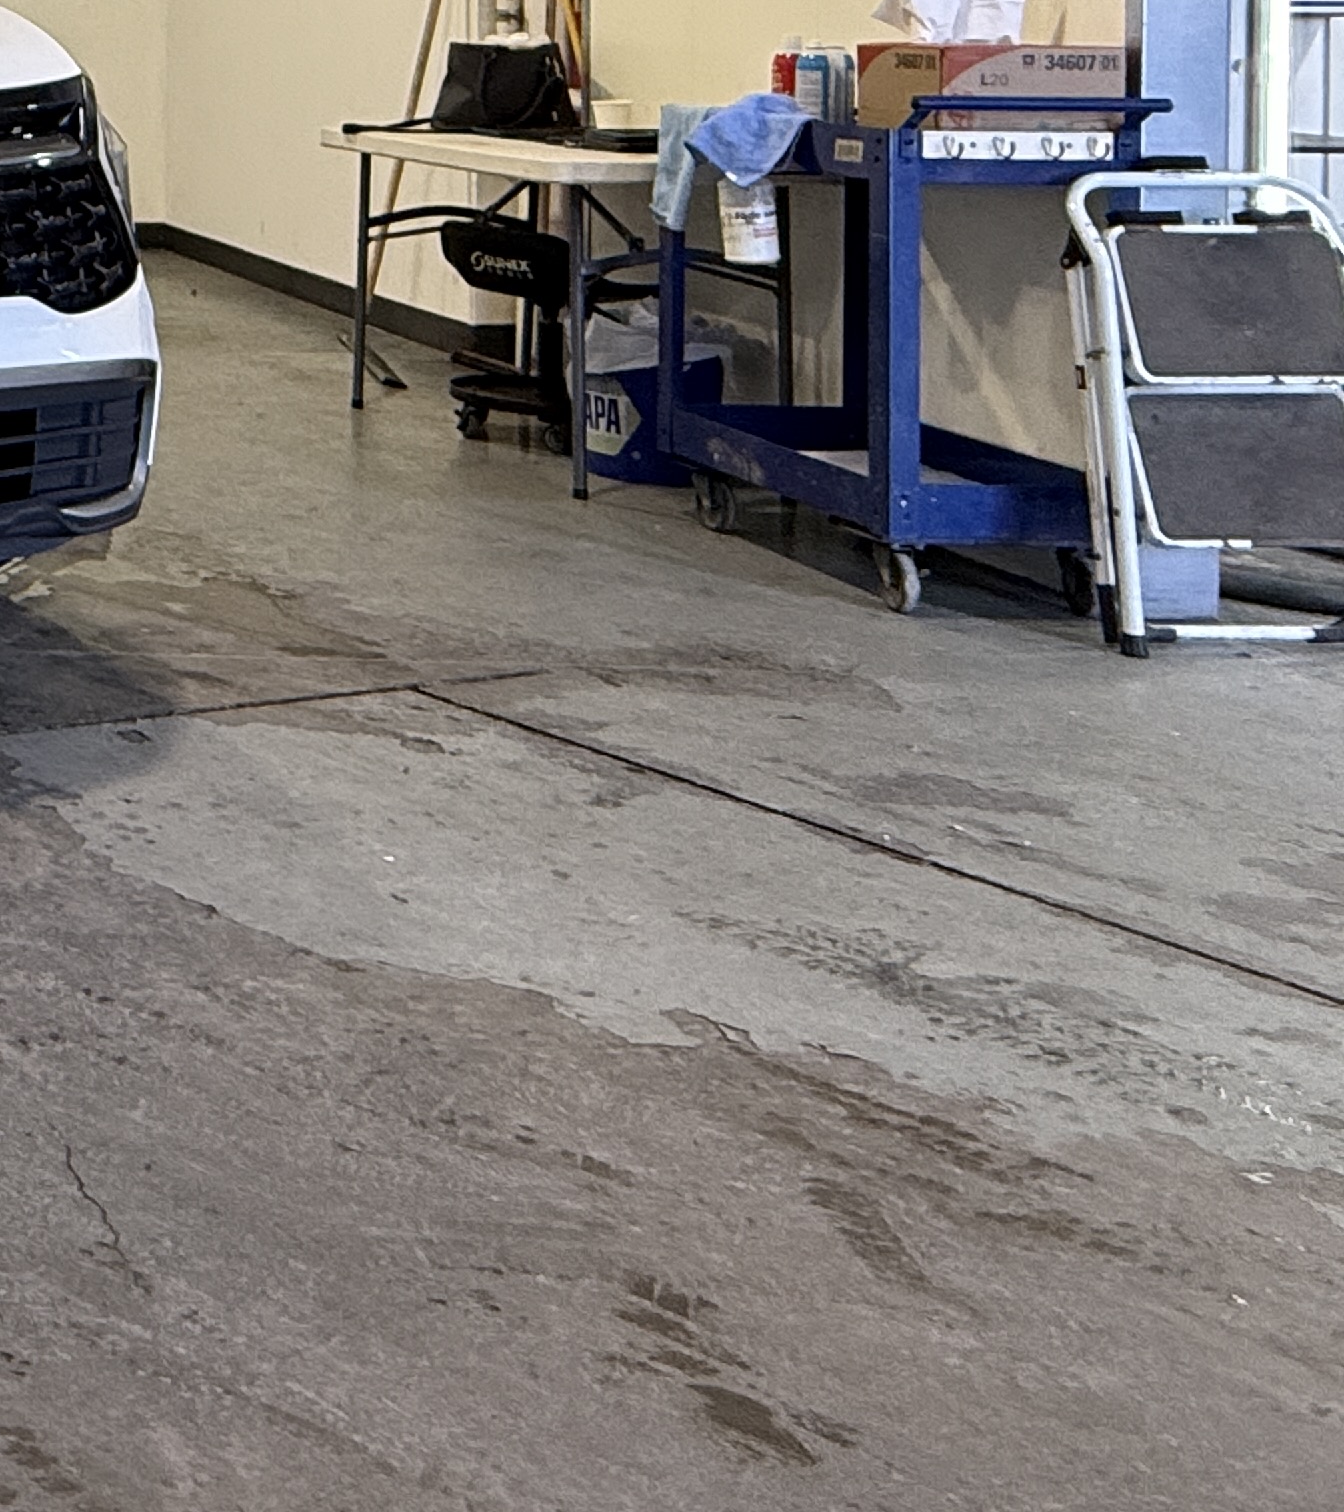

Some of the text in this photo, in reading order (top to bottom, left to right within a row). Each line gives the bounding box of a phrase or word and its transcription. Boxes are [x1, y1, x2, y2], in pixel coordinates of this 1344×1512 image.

[1044, 54, 1119, 72] 34607 01
[980, 73, 1009, 86] L20
[584, 391, 622, 435] APA
